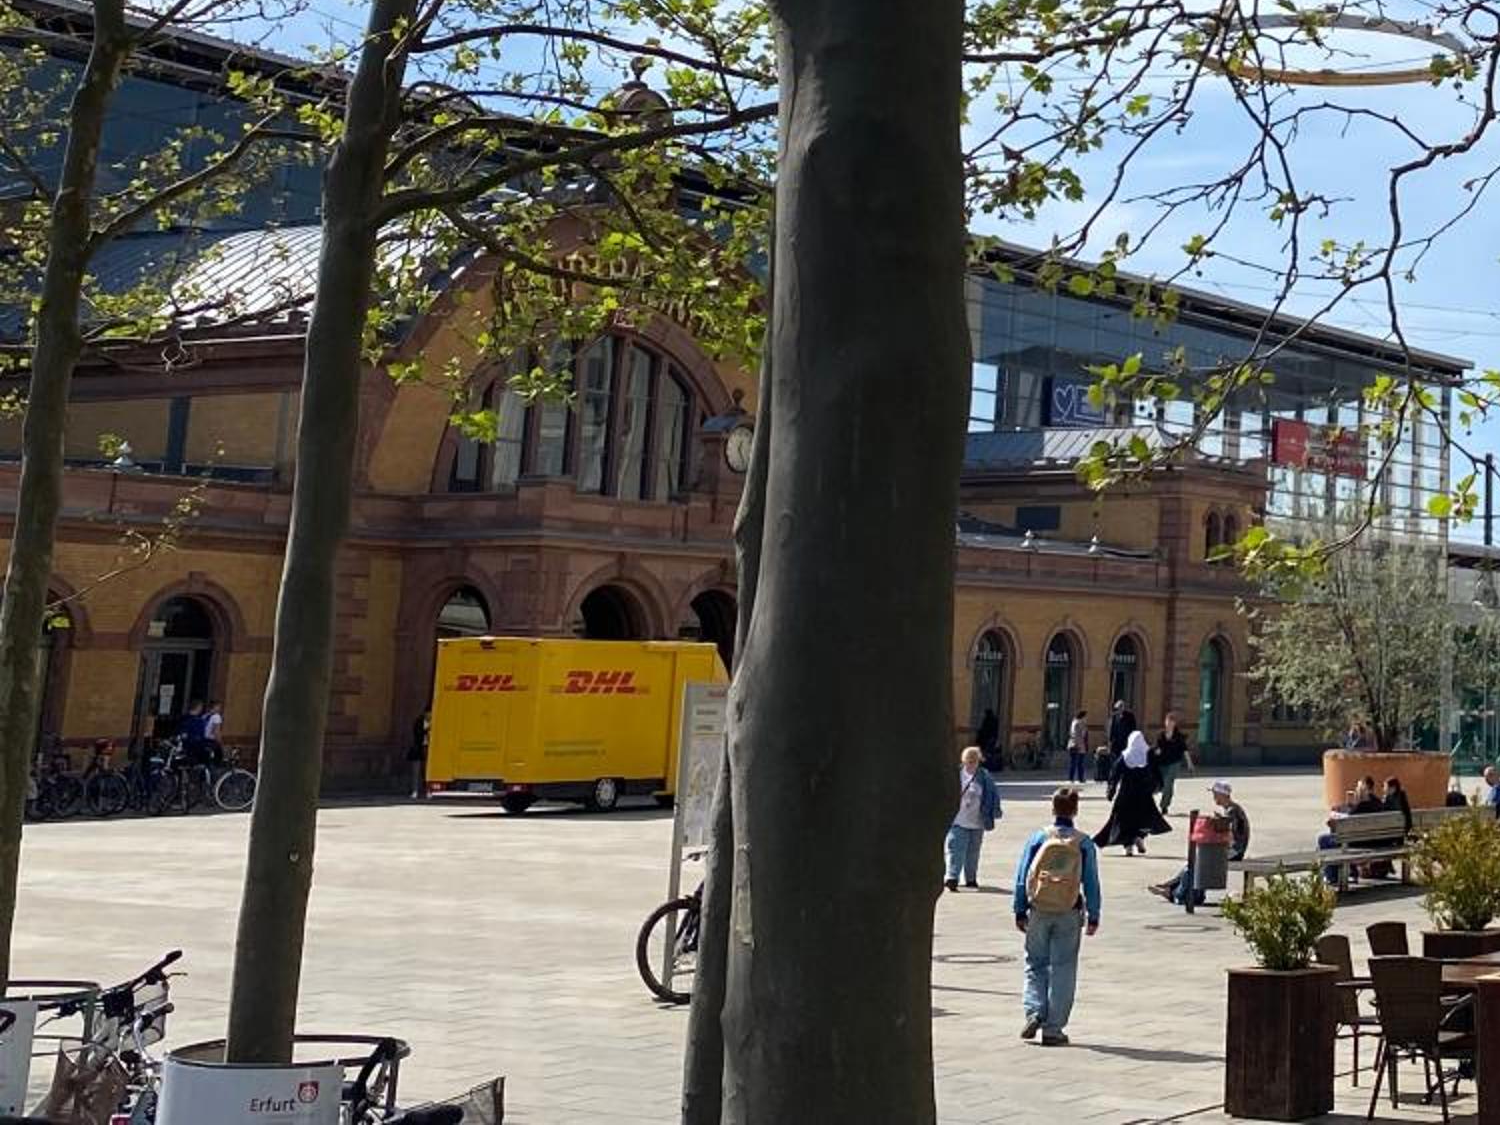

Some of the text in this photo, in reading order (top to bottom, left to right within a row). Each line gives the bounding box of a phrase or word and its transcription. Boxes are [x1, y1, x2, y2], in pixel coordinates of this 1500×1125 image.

[456, 674, 514, 692] DHL
[564, 670, 636, 694] DHL
[249, 1096, 296, 1112] Erfurt
